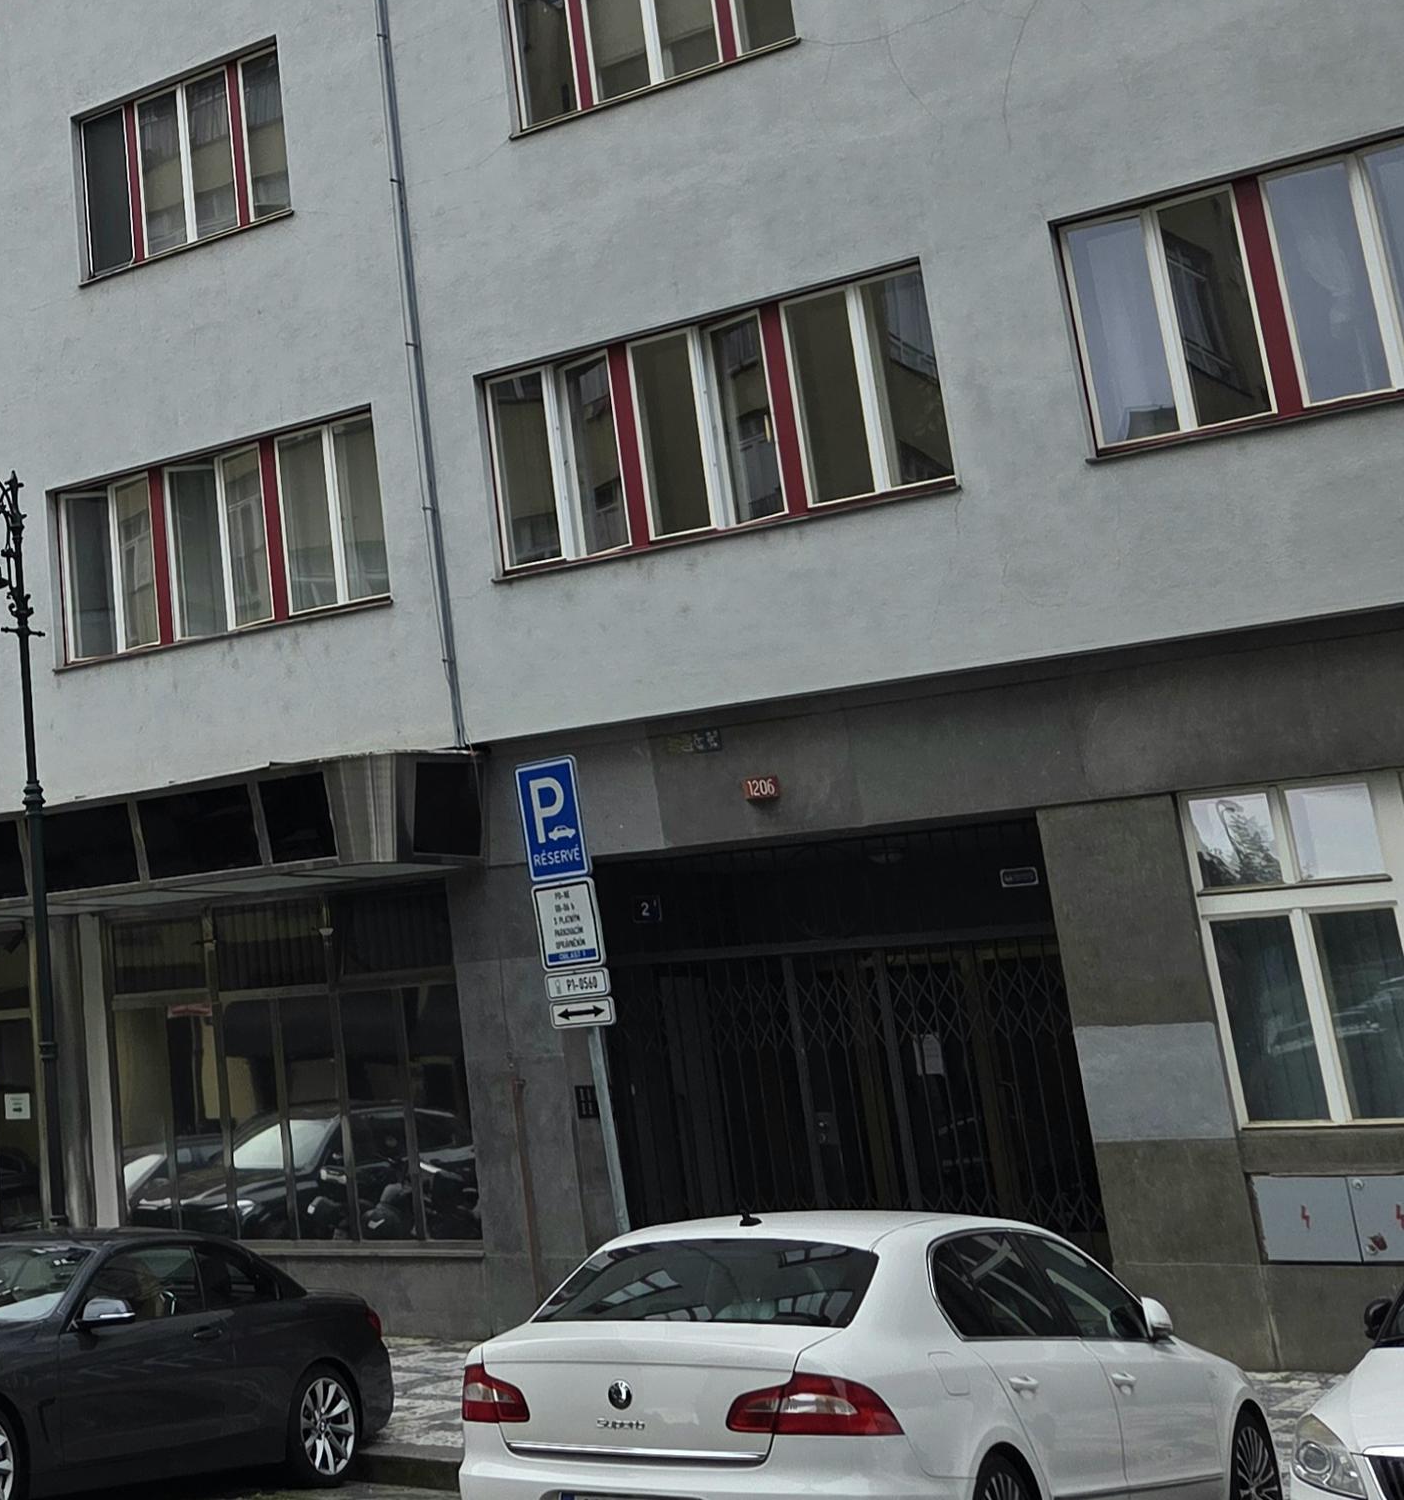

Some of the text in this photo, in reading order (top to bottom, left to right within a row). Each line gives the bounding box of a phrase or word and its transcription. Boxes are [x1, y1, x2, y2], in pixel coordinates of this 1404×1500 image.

[747, 778, 776, 797] 1206
[529, 776, 565, 845] P
[533, 844, 582, 867] RÉSERVÉ
